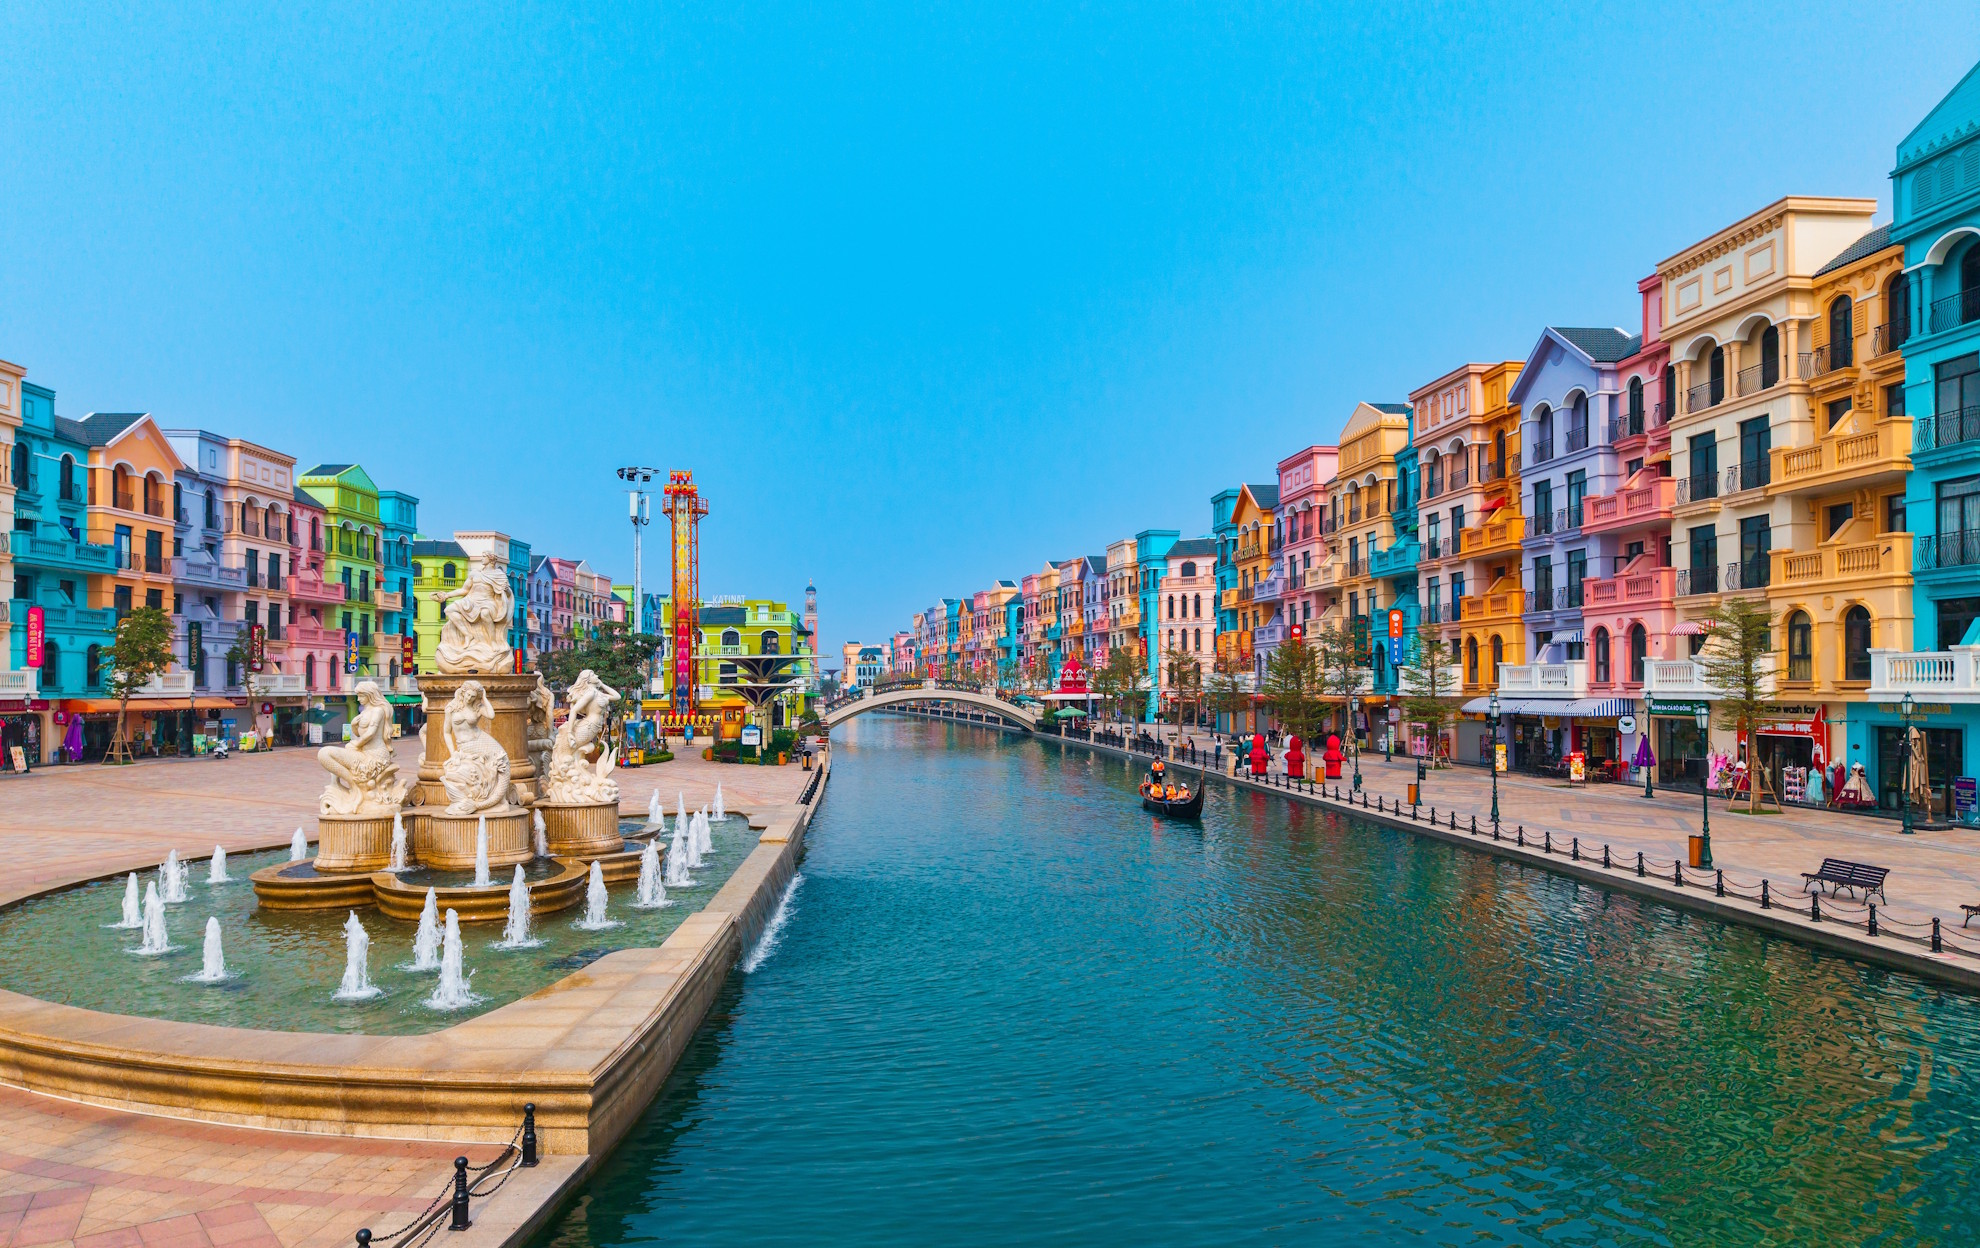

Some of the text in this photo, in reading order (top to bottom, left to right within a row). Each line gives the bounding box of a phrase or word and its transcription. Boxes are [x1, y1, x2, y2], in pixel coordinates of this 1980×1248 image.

[670, 470, 692, 481] SKY
[664, 484, 698, 495] DROP
[712, 594, 746, 605] KATINAT
[29, 613, 38, 661] RAINBOW
[1783, 704, 1802, 713] wash
